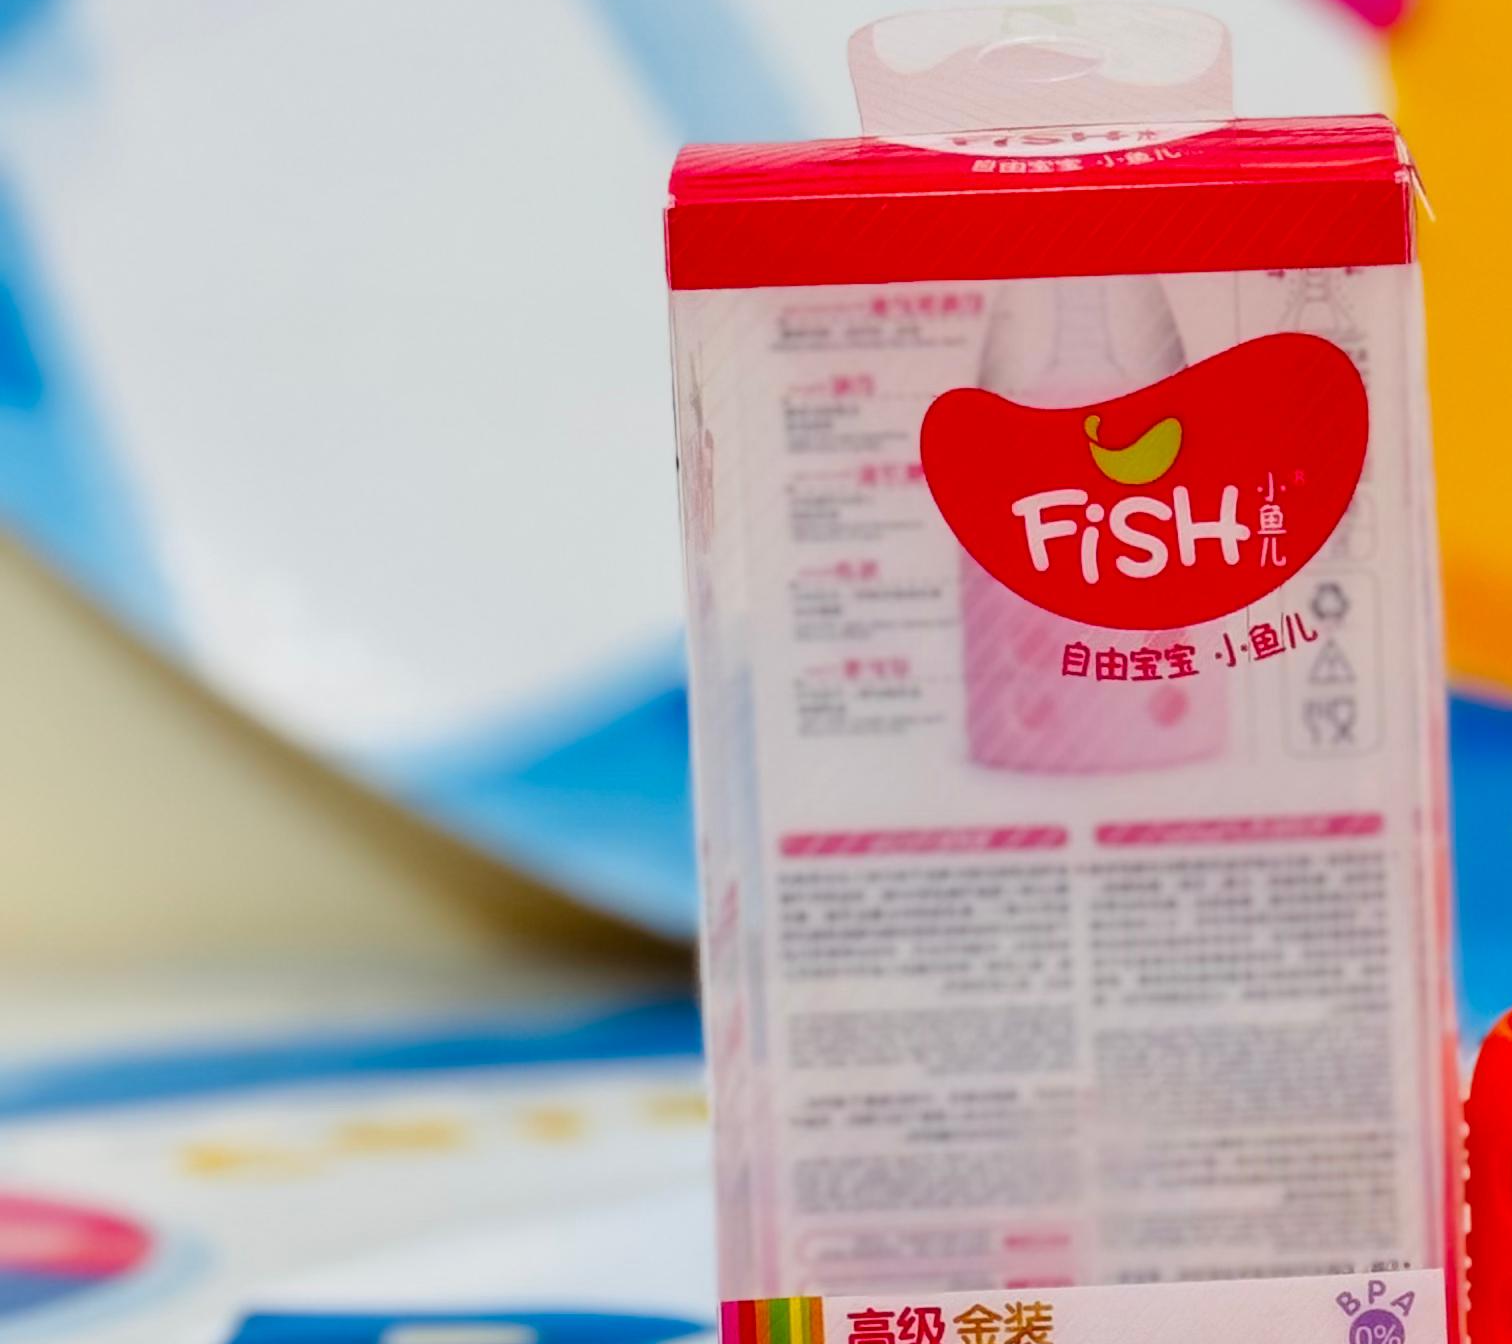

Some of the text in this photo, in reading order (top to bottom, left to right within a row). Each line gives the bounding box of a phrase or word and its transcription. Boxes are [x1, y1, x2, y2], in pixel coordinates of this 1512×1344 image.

[1256, 471, 1287, 568] 小鱼儿
[1061, 641, 1200, 682] 自由宝宝
[1335, 1279, 1416, 1317] BPA
